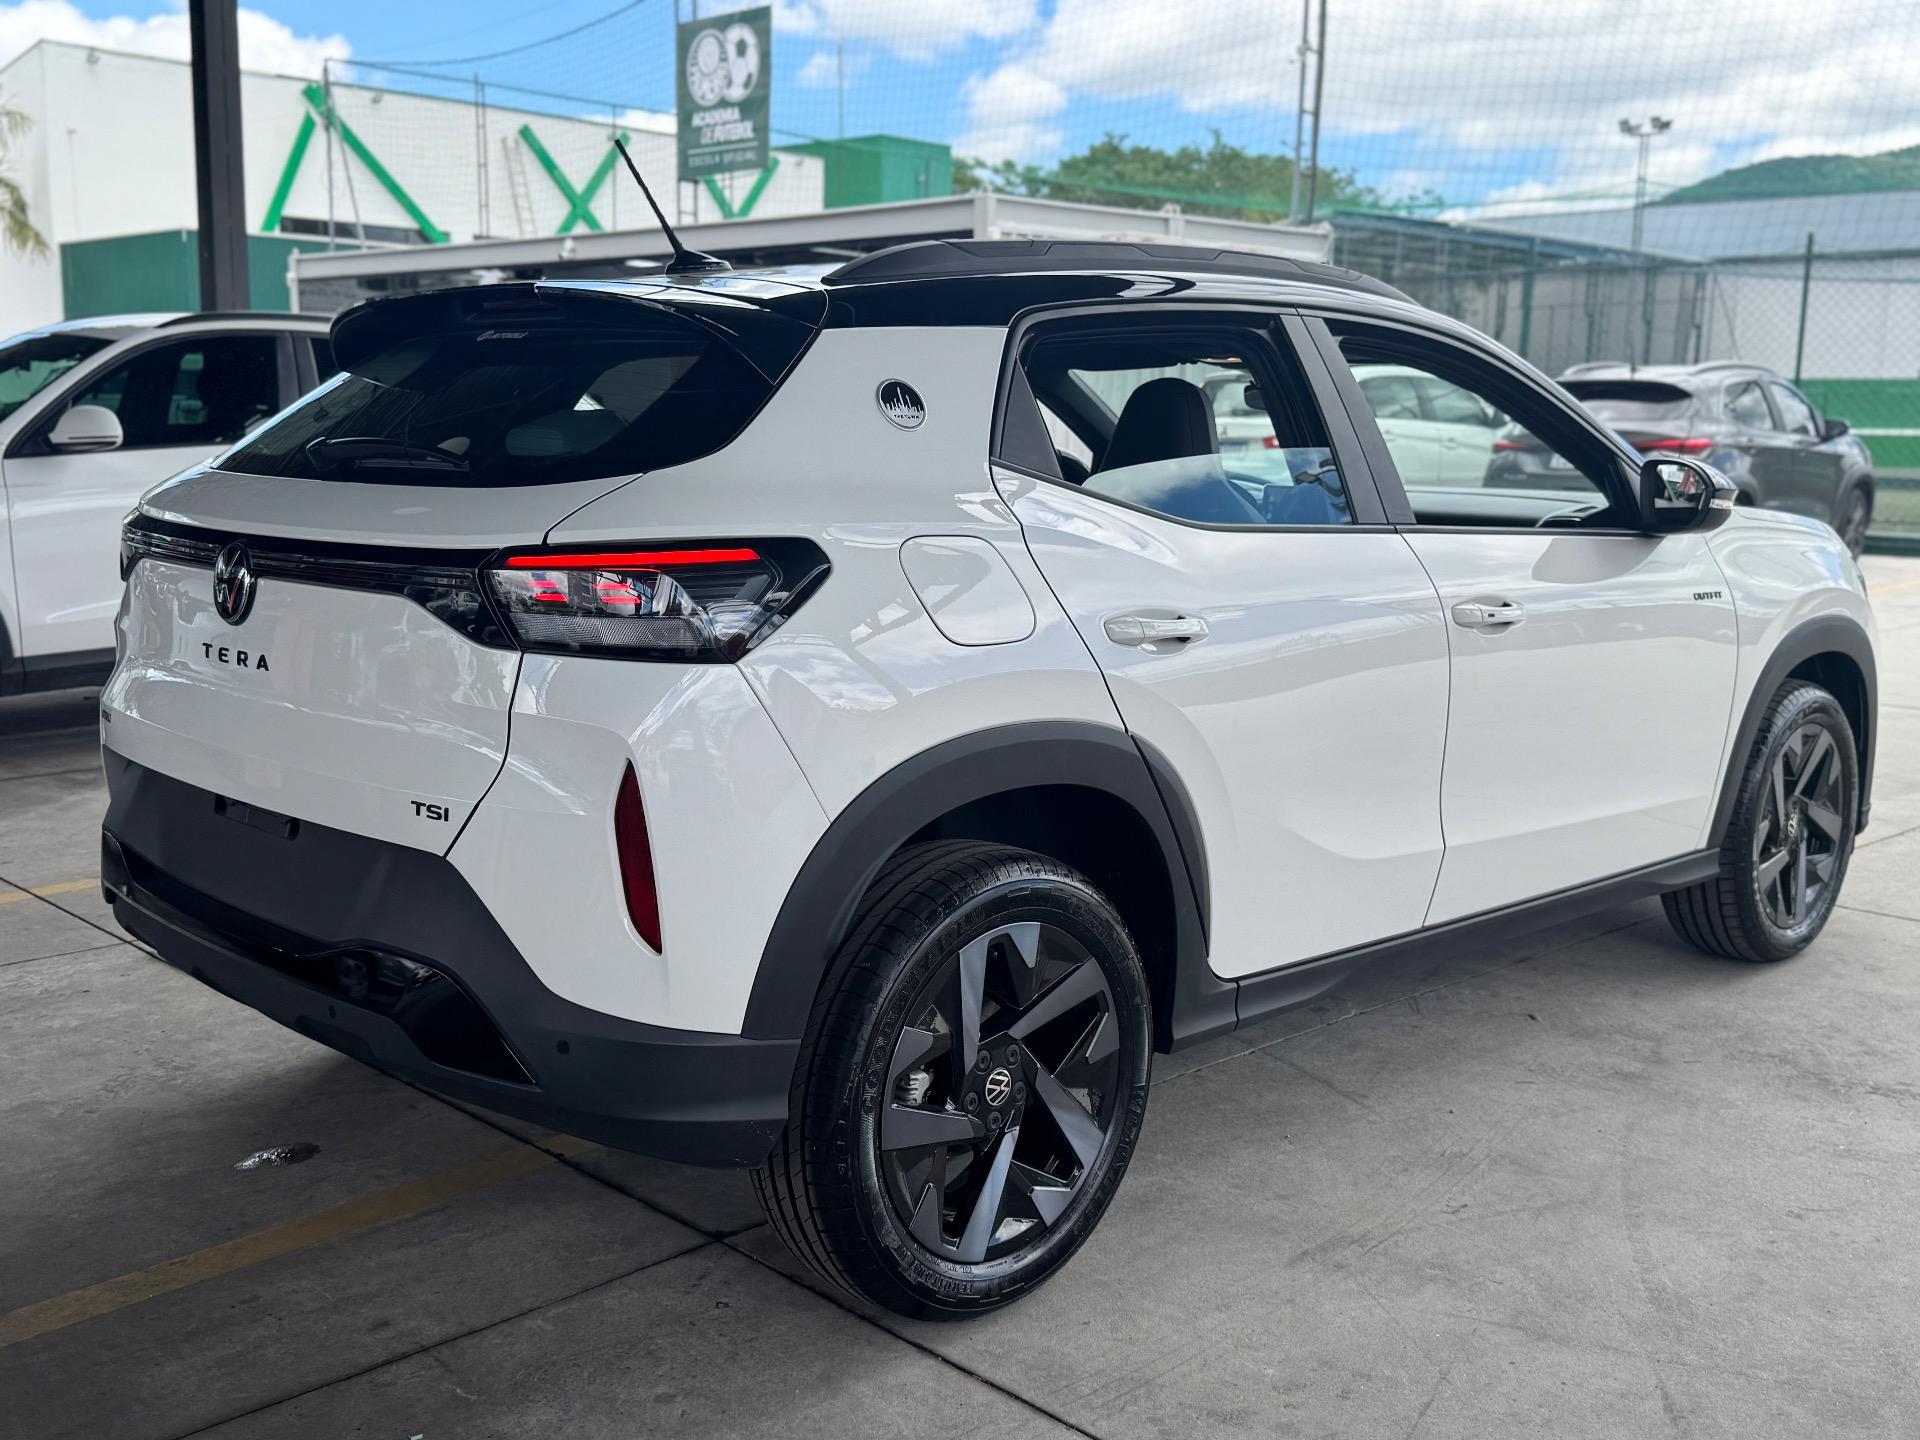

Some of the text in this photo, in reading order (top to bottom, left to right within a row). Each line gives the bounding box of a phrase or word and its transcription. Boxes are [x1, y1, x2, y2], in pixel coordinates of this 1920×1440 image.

[1693, 591, 1722, 601] OUTFIT
[202, 642, 270, 672] TERA
[411, 800, 450, 823] TSI
